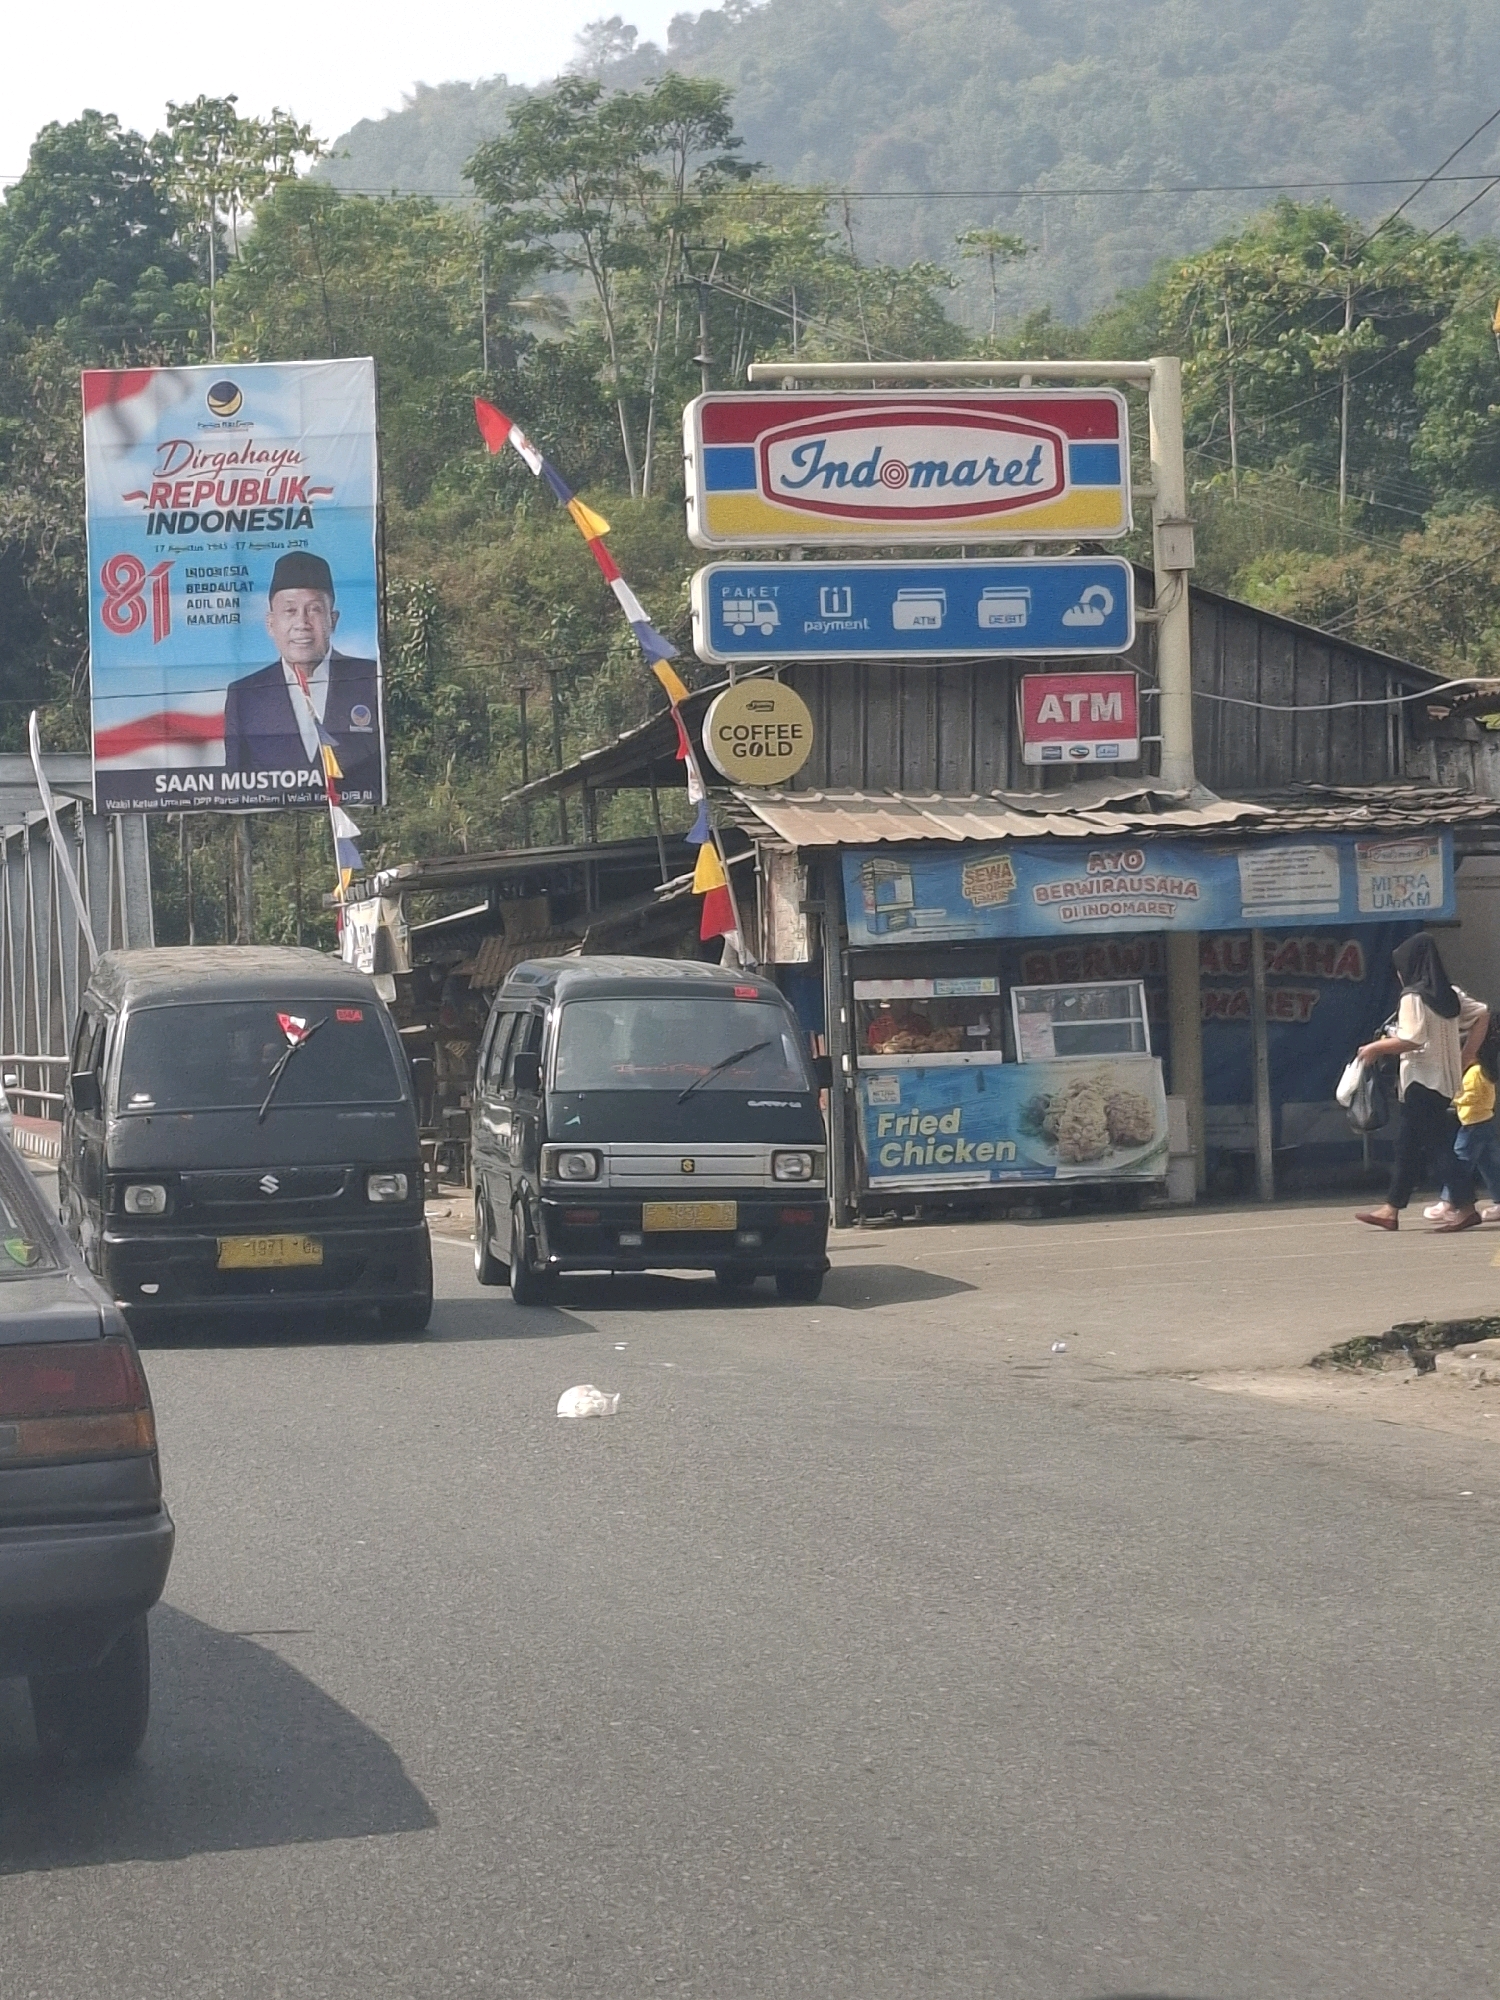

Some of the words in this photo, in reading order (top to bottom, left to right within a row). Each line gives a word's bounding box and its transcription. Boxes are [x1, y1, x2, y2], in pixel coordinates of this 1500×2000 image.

[153, 439, 307, 479] Dirgahayu
[780, 439, 1044, 489] Indomaret
[149, 476, 311, 509] REPUBLIK
[146, 506, 314, 535] INDONESIA
[185, 565, 249, 578] INDONESIA
[186, 581, 254, 593] BERDAULAT
[722, 586, 780, 598] PAKET
[101, 553, 176, 646] 81
[804, 618, 869, 634] payment
[1037, 692, 1123, 724] ATM
[719, 724, 803, 741] COFFEE
[733, 741, 793, 758] GOLD
[155, 773, 214, 793] SAAN
[221, 769, 323, 790] MUSTOPA
[965, 861, 1013, 885] SEWA
[1088, 850, 1144, 872] AYO
[1035, 877, 1199, 903] BERWIRAUSAHA
[1372, 874, 1430, 891] MITRA
[1061, 905, 1079, 920] DI
[1082, 902, 1175, 917] INDOMARET
[877, 1108, 961, 1138] Fried
[879, 1138, 1016, 1167] Chicken
